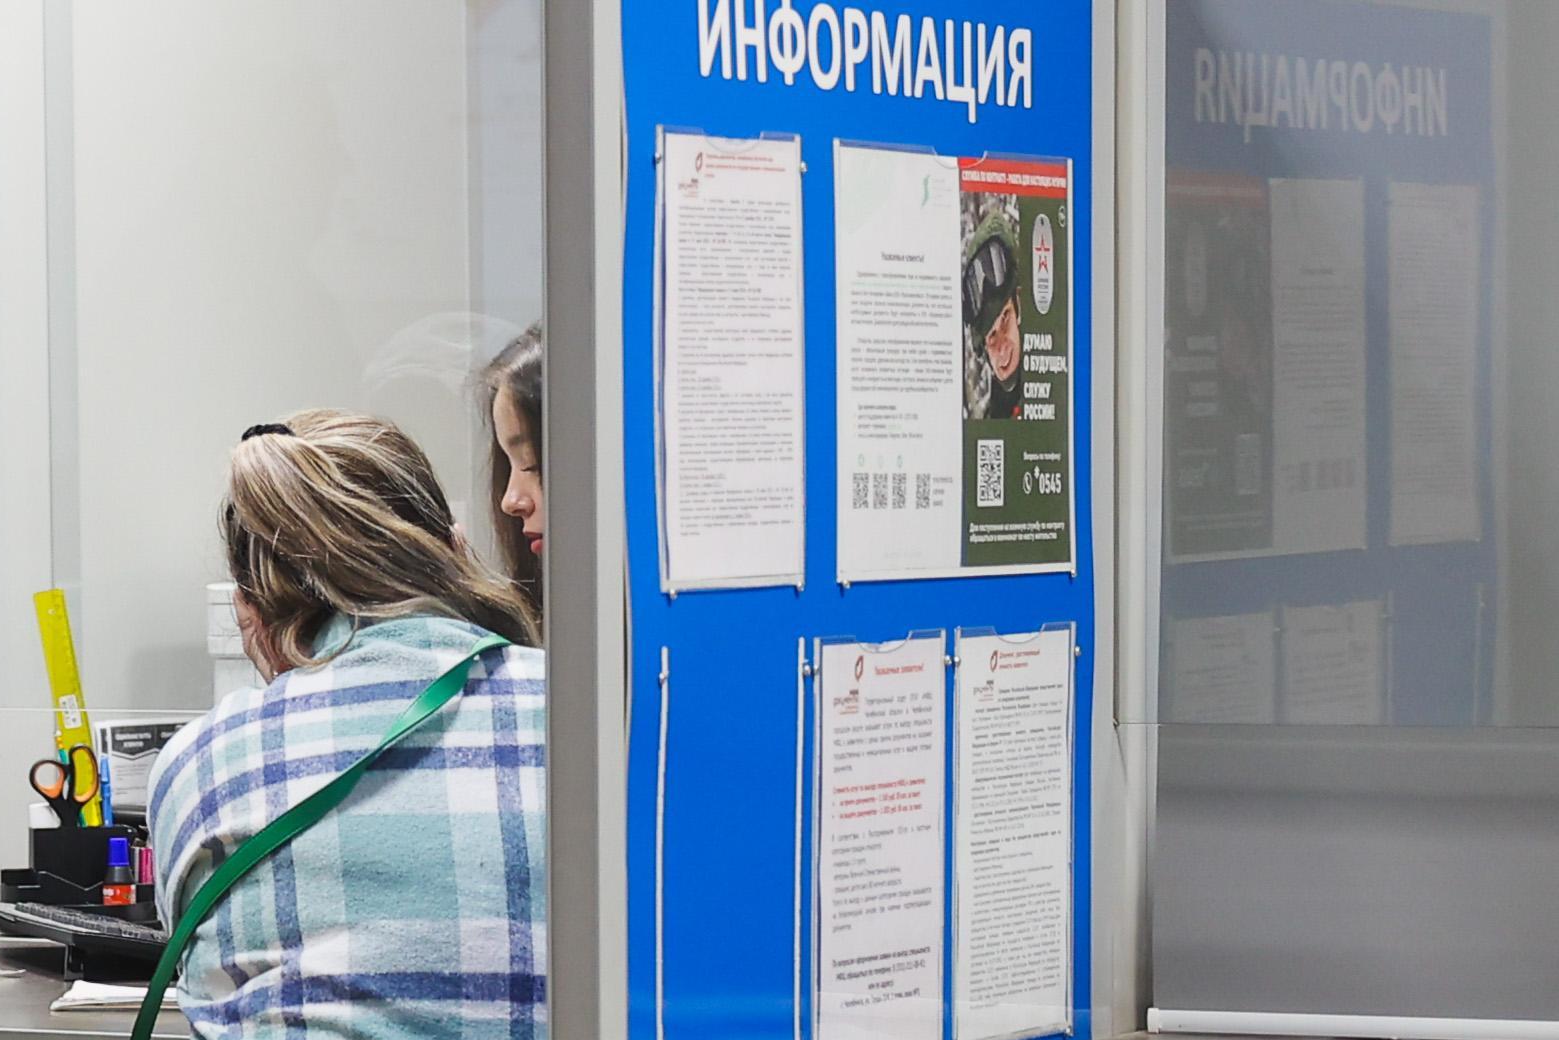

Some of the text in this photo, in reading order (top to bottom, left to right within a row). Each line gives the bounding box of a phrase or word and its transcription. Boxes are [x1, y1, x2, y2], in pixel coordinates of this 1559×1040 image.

[697, 0, 1033, 123] ИНФОРМАЦИЯ
[1024, 334, 1053, 353] ДУМАЮ
[1024, 354, 1068, 374] О БУДУЩЕМ,
[1024, 382, 1051, 399] СЛУЖУ
